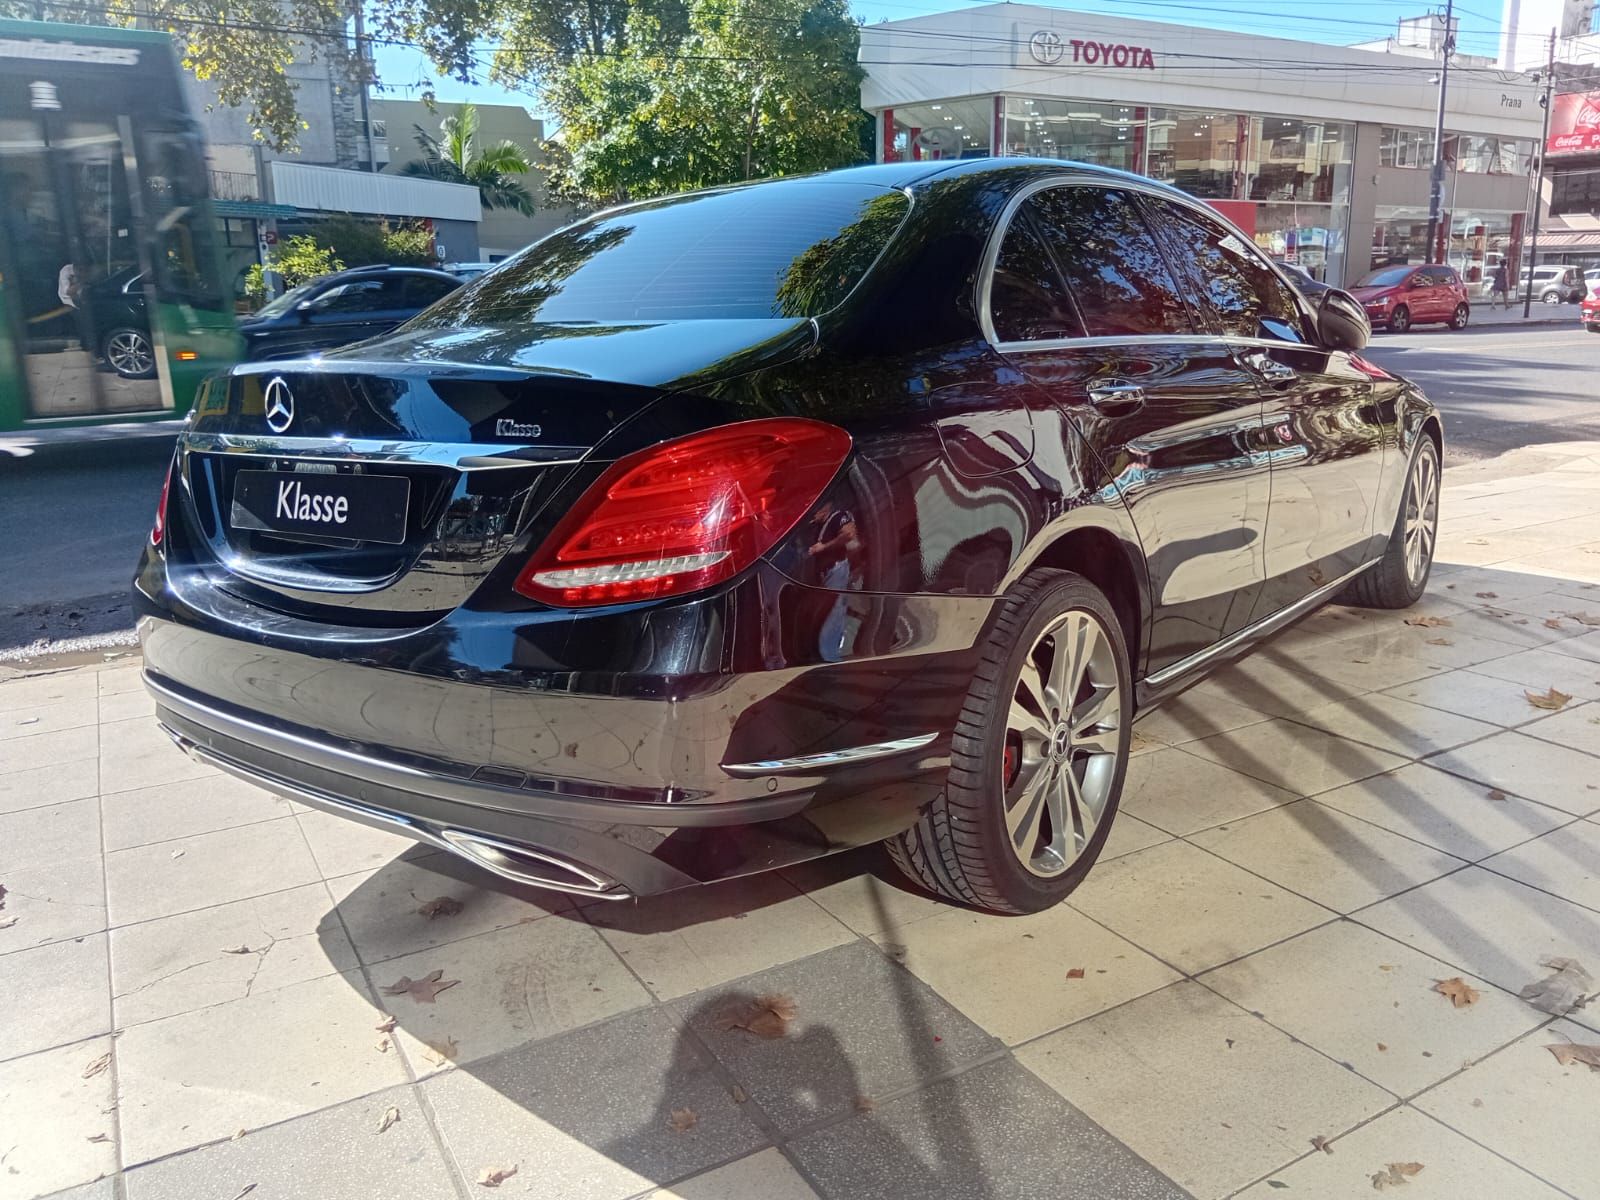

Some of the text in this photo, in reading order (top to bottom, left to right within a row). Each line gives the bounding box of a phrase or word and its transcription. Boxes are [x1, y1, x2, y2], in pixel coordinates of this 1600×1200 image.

[1070, 40, 1155, 72] TOYOTA
[1501, 94, 1522, 109] Prana
[496, 419, 541, 437] Klasse
[276, 480, 349, 523] Klasse
